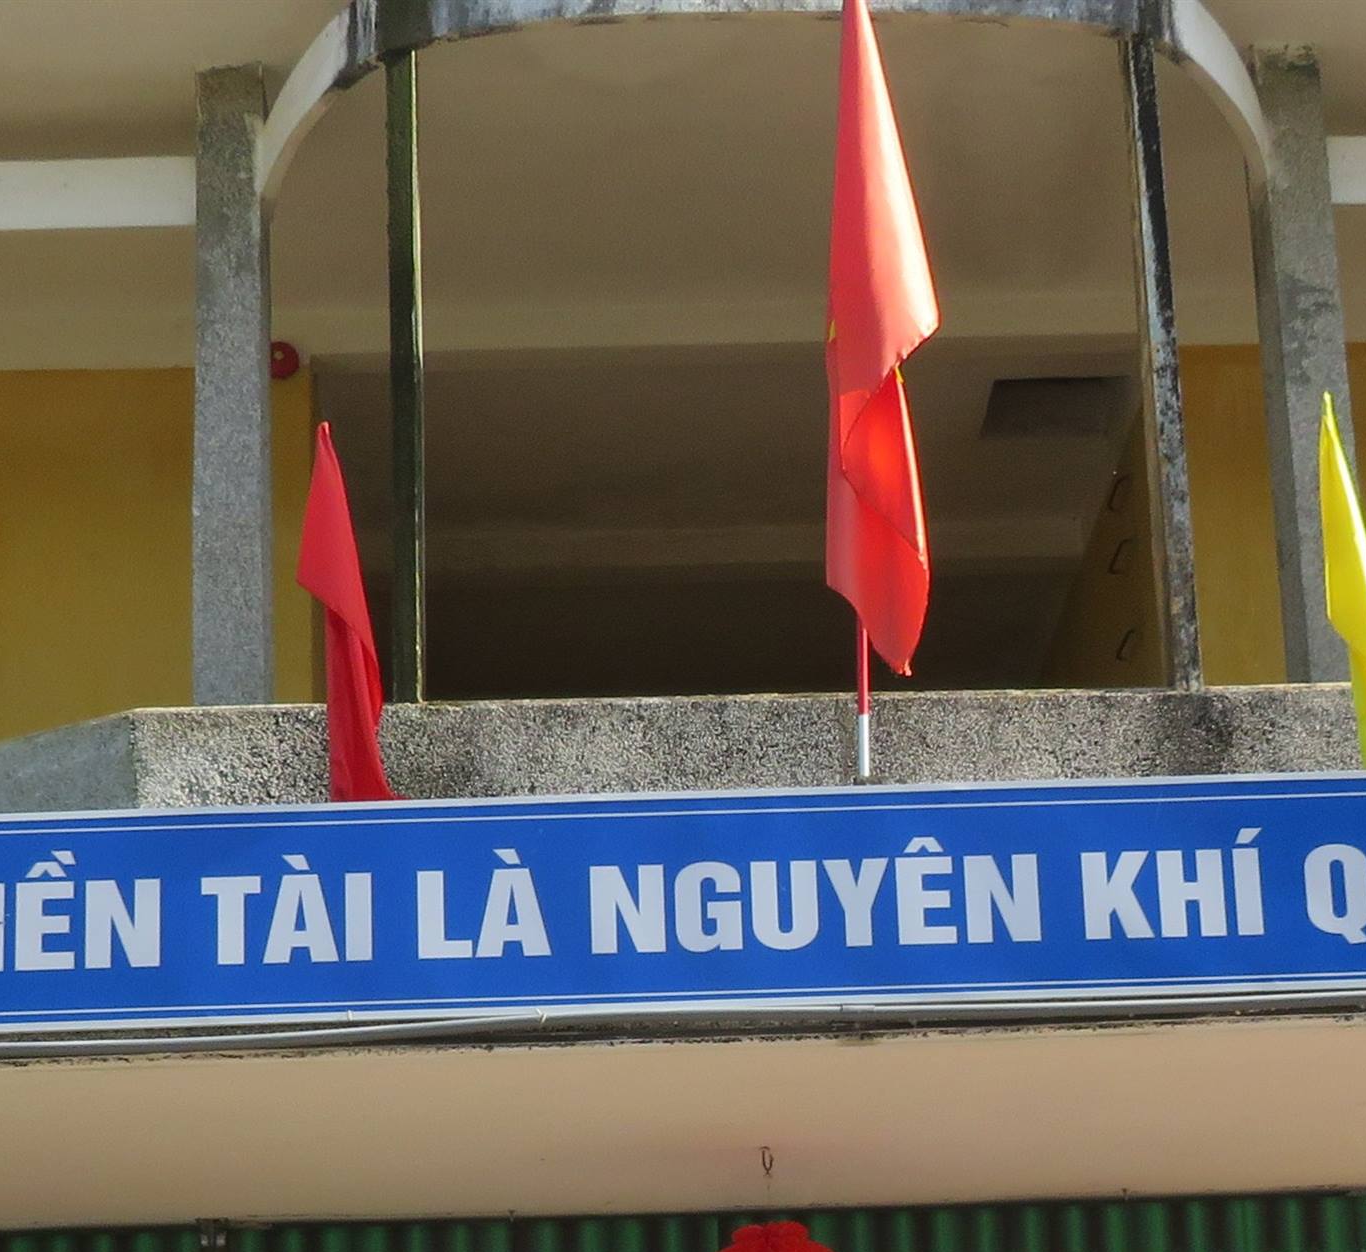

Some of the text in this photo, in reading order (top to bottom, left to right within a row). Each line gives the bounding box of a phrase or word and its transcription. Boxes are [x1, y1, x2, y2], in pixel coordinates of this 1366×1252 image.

[202, 854, 374, 967] TÀI
[417, 848, 552, 961] LÀ
[590, 836, 1042, 955] NGUYÊN
[1081, 827, 1265, 941] KHÍ
